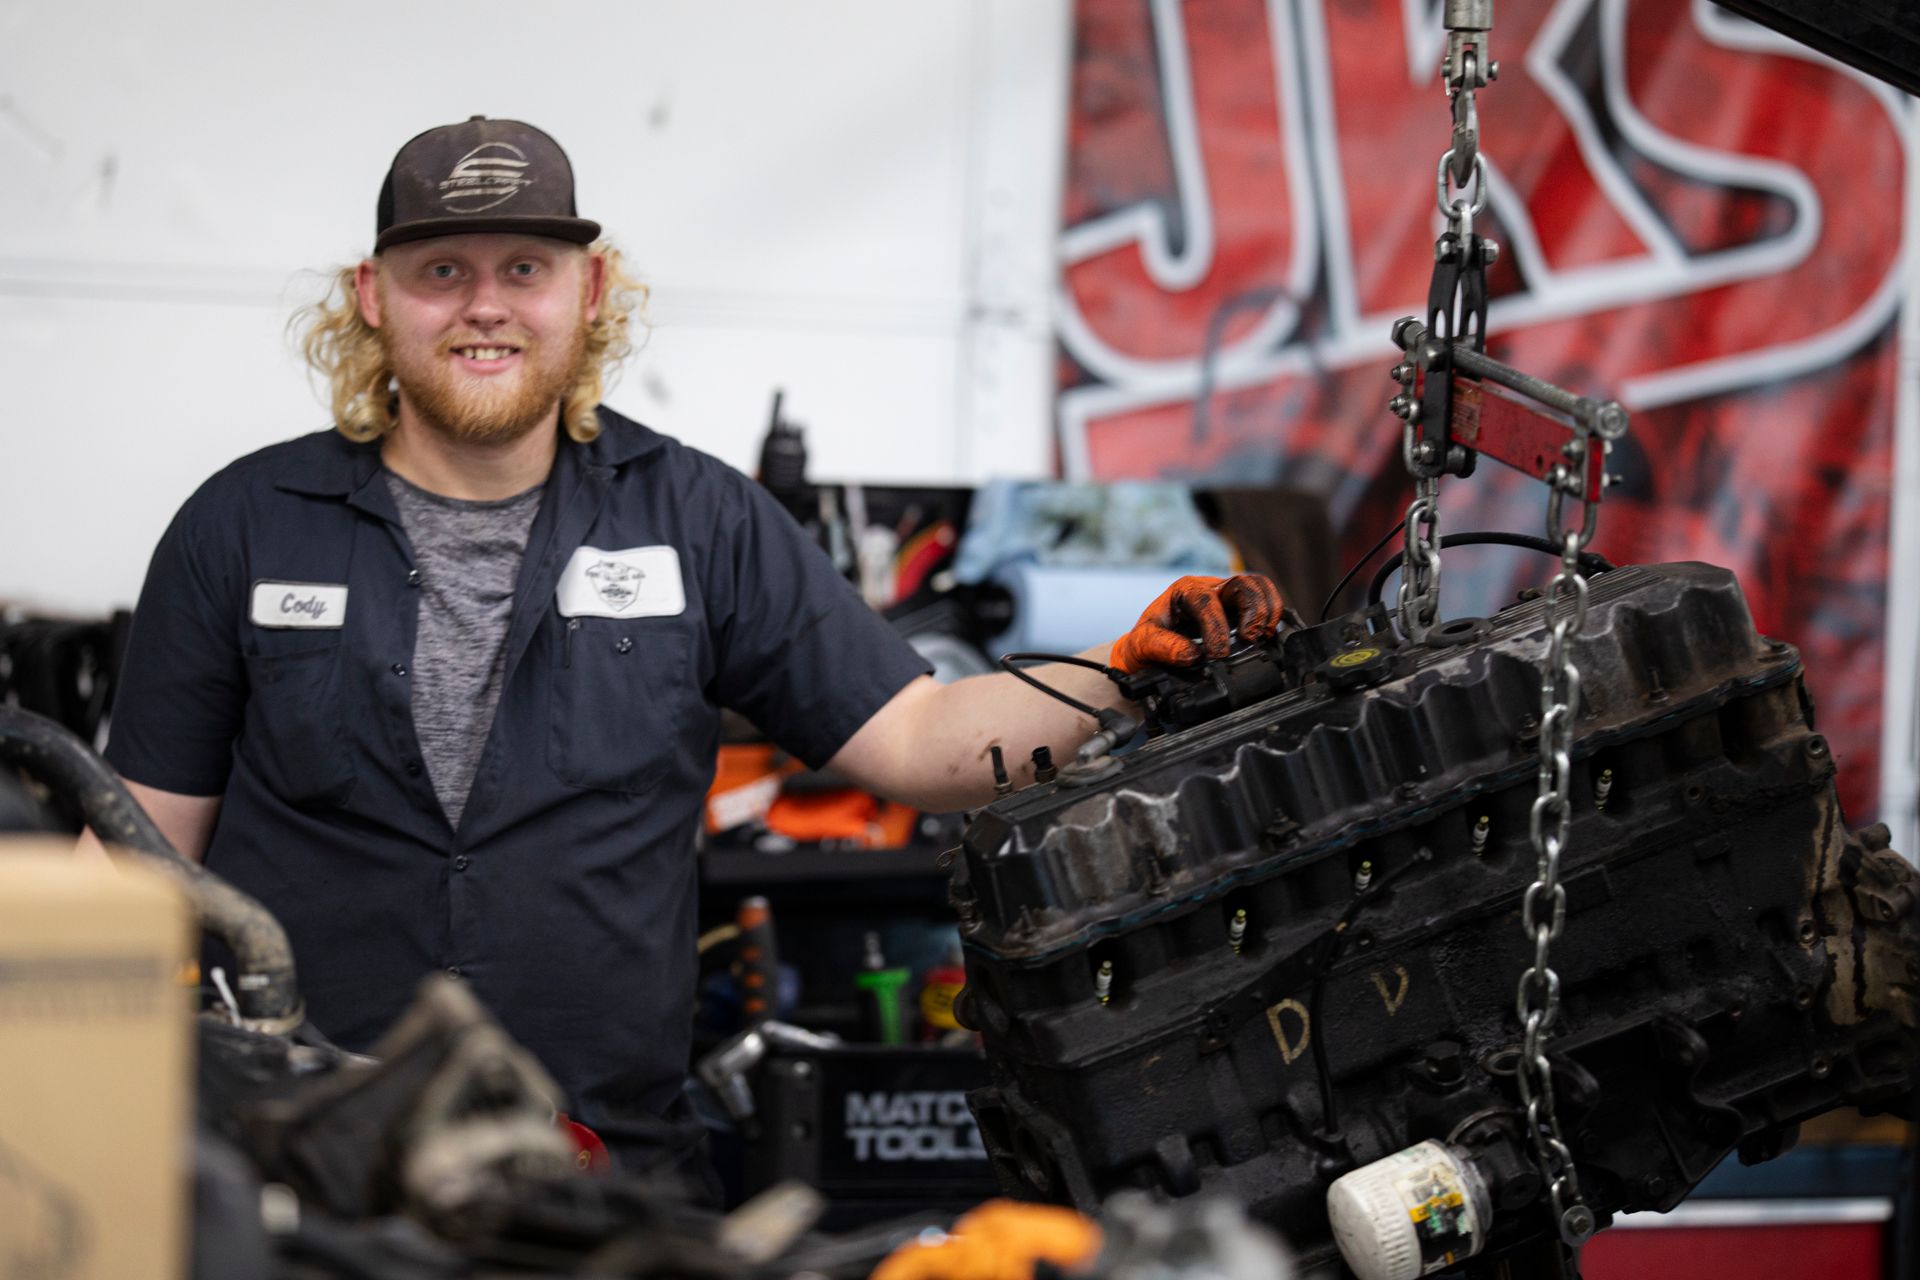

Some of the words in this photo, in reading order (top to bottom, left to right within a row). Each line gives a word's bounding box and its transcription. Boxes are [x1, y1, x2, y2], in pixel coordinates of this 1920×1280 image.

[1060, 0, 1907, 407] JKS
[281, 592, 328, 619] Cody
[1266, 998, 1310, 1065] D
